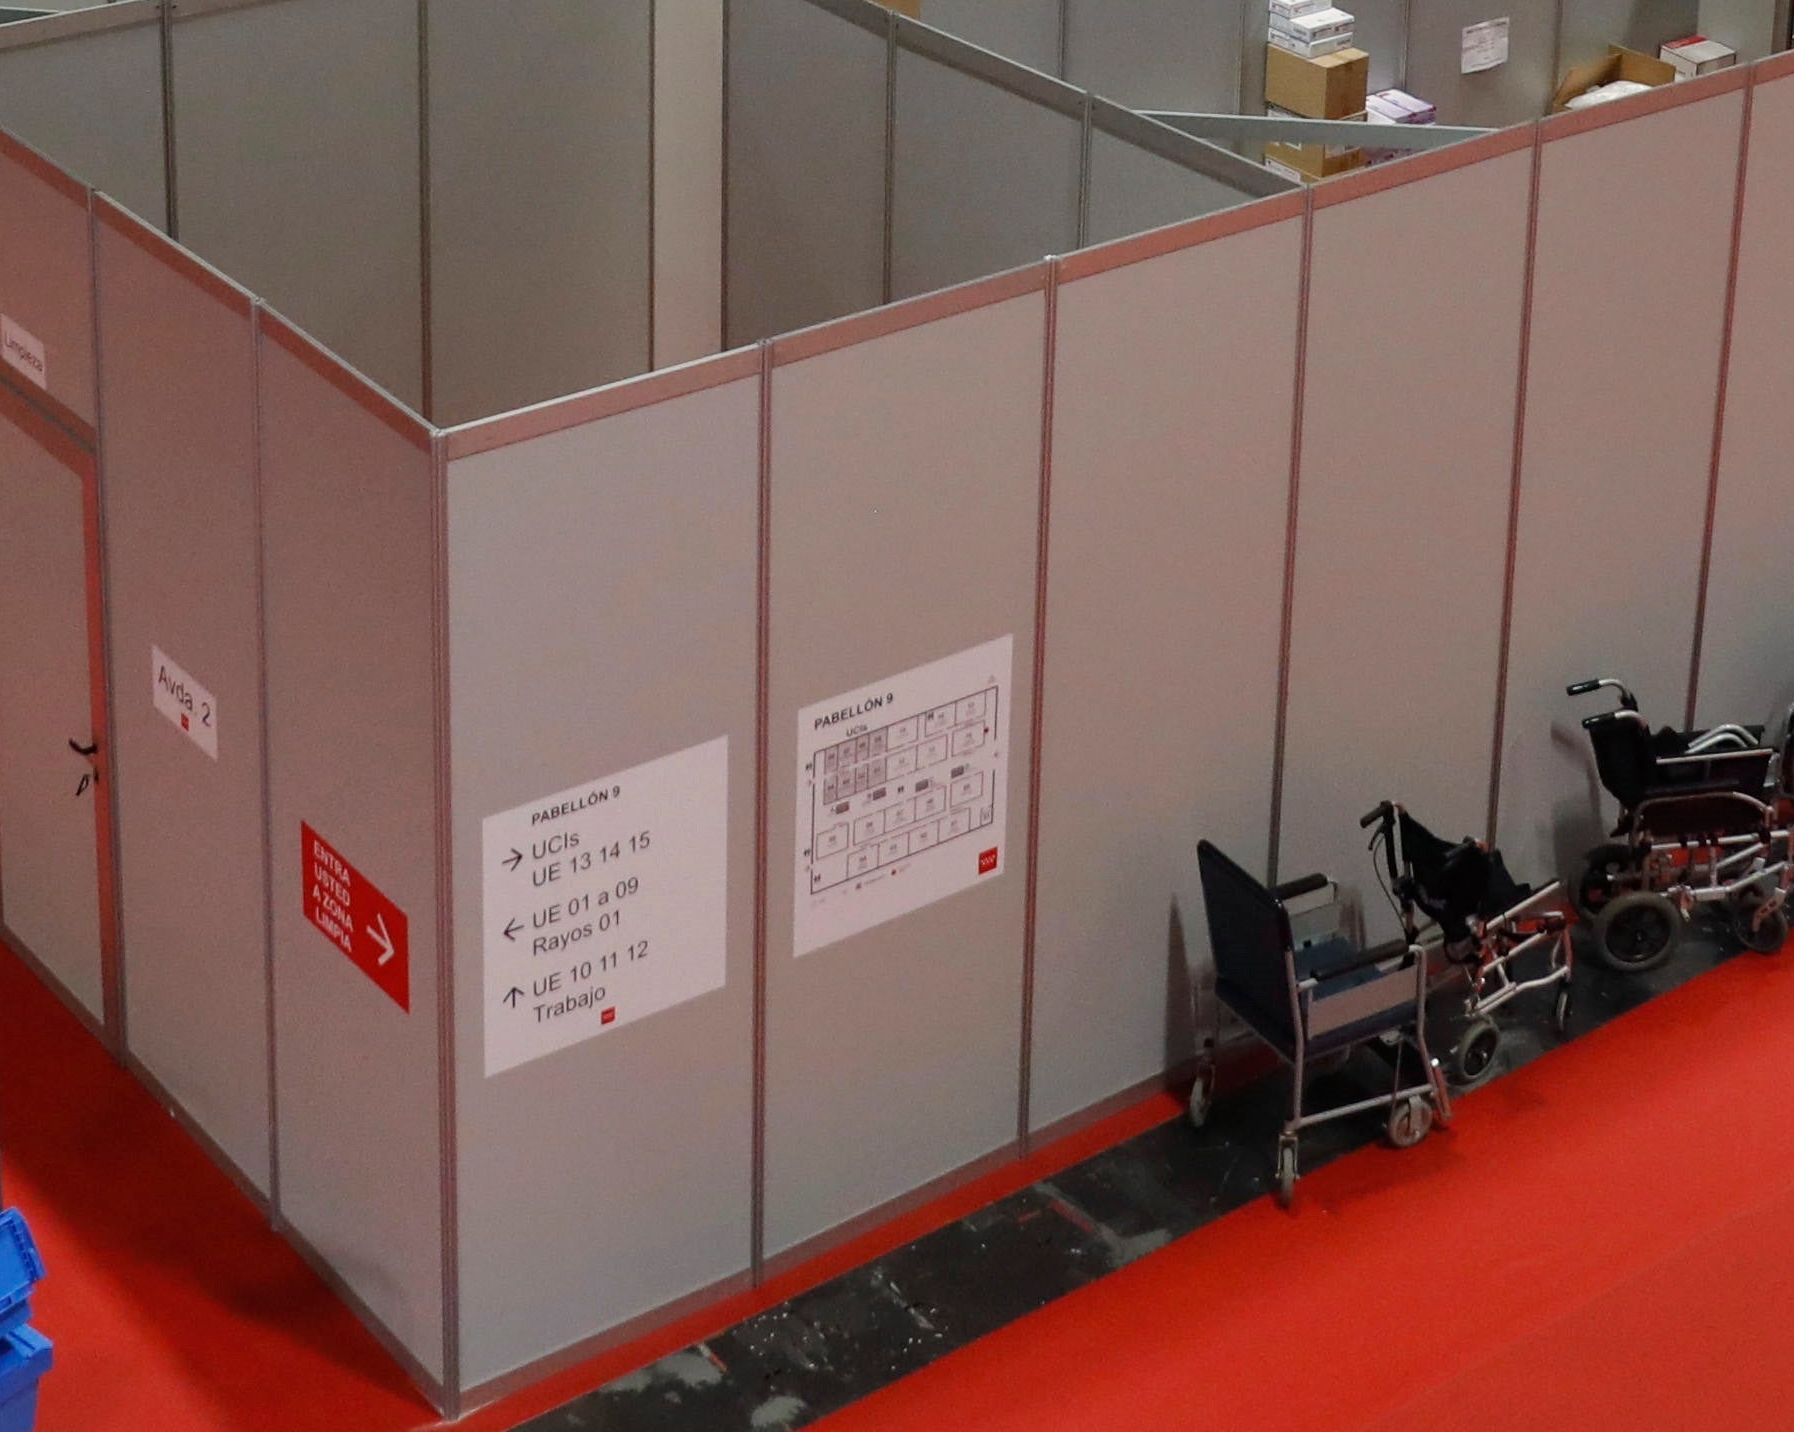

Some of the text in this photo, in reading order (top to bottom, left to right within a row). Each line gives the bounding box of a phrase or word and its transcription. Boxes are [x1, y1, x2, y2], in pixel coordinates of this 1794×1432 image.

[158, 665, 211, 727] Avda. 2
[814, 692, 894, 730] PABELLÓN 9
[531, 785, 621, 825] PABELLÓN 9
[313, 839, 351, 887] ENTRA
[532, 831, 580, 860] UCIs
[533, 831, 651, 887] UE 13 14 15
[312, 883, 353, 932] A ZONA
[314, 862, 351, 907] USTED
[533, 876, 639, 929] UE 01 a 09
[315, 906, 352, 953] LIMPIA
[532, 909, 620, 956] Rayos 01
[533, 939, 649, 997] UE 10 11 12
[533, 985, 607, 1023] Trabajo
